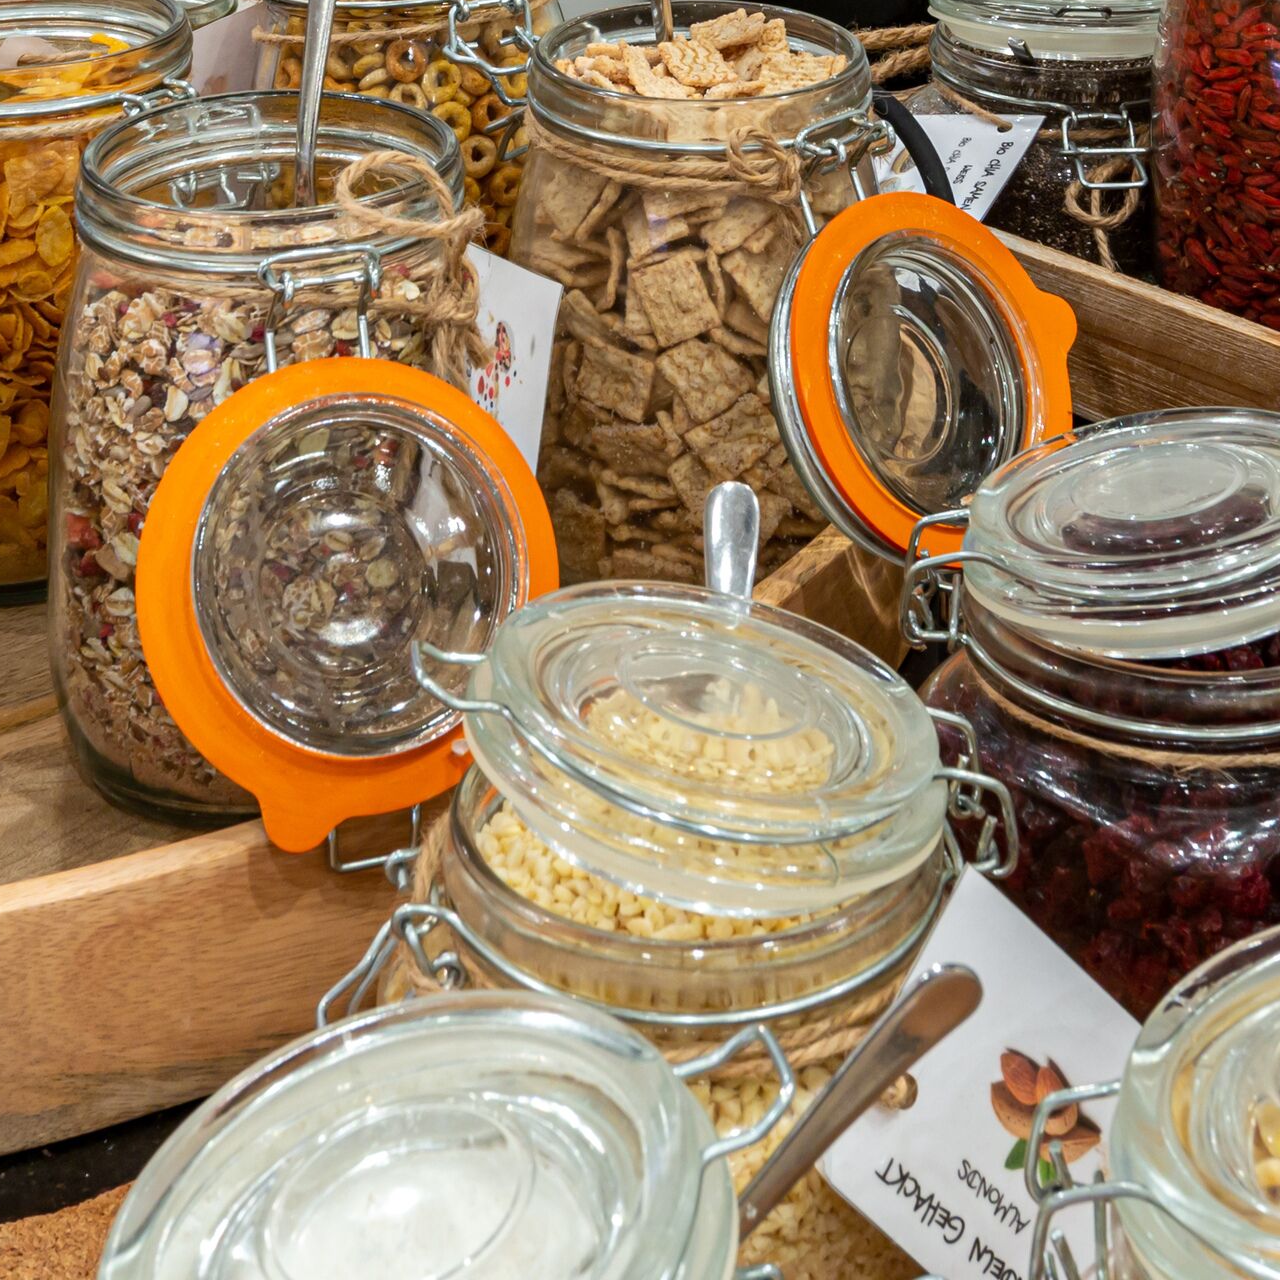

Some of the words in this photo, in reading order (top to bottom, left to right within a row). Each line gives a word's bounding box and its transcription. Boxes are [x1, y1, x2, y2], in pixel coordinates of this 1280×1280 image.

[996, 141, 1015, 156] BIO
[981, 158, 1002, 178] CHIA
[960, 180, 988, 210] SAMEN
[875, 1157, 966, 1245] GEHACKT
[957, 1158, 1032, 1235] ALMONDS
